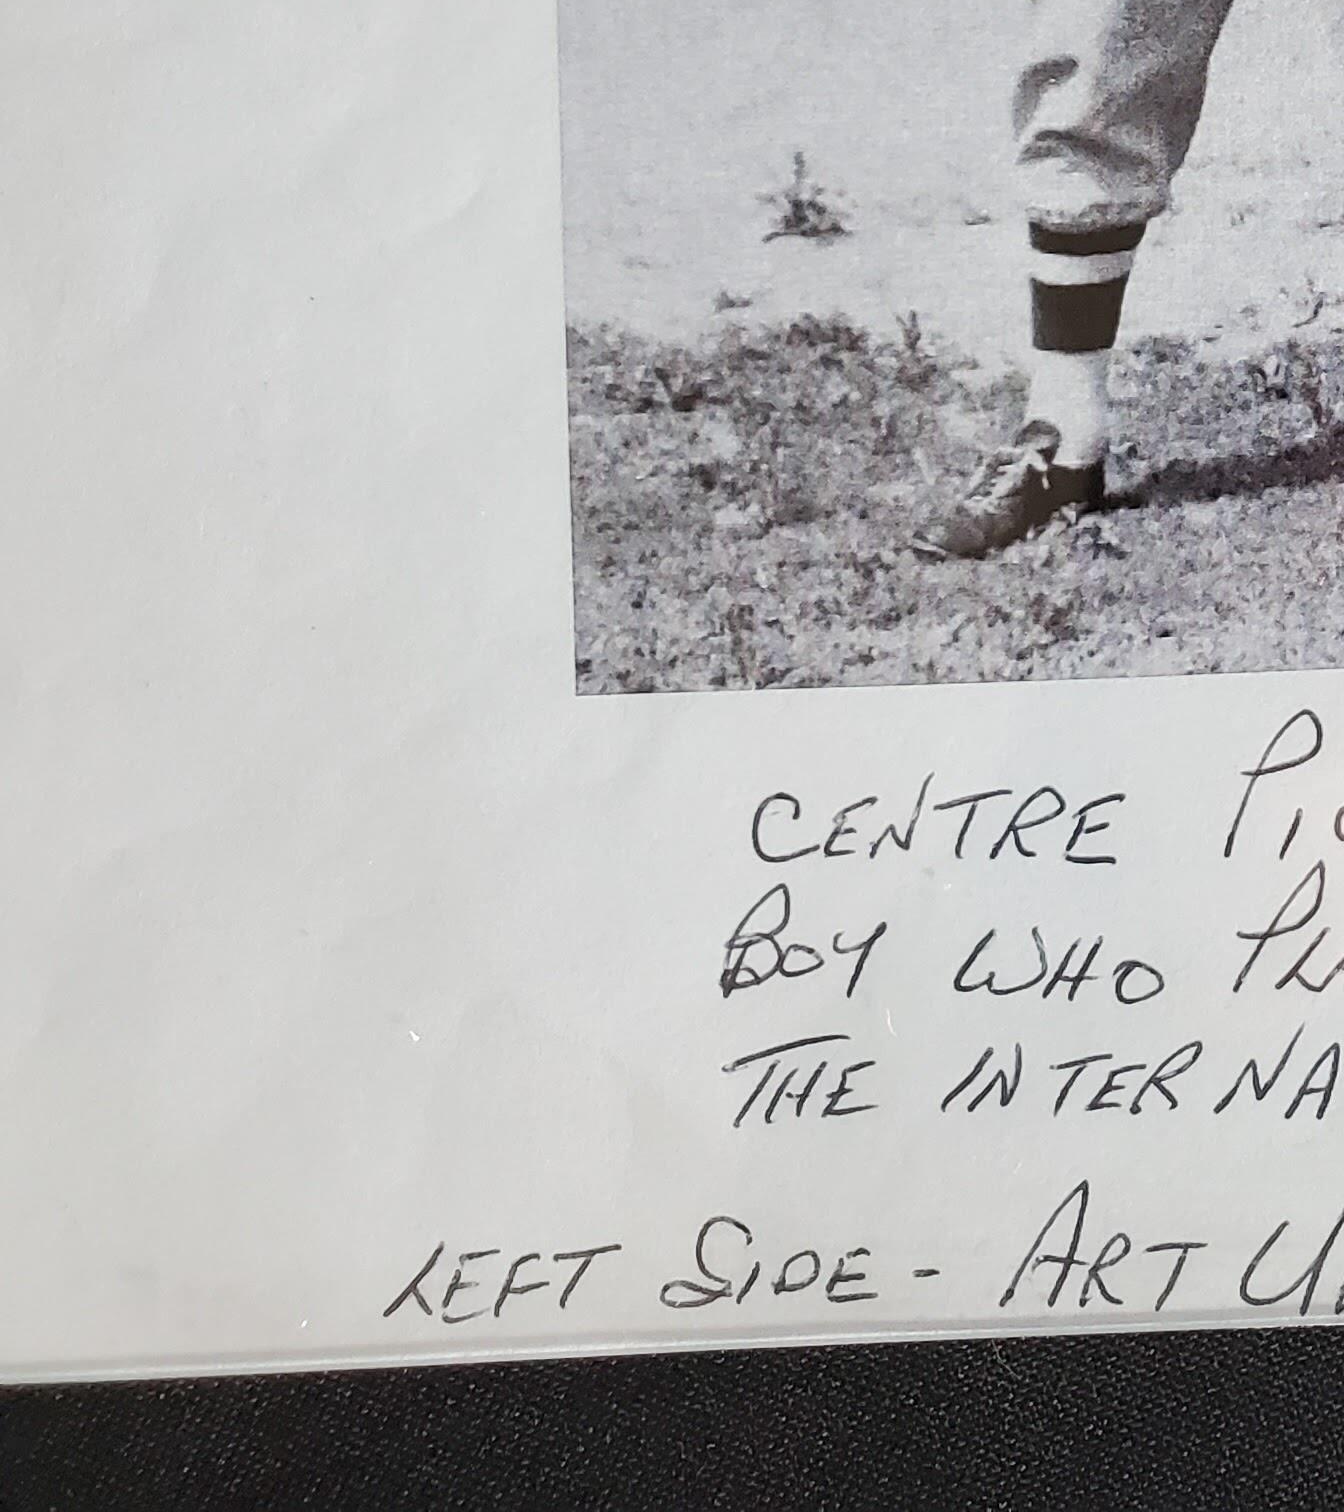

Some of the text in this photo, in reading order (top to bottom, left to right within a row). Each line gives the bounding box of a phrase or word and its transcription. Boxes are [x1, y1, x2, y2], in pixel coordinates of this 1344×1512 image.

[752, 772, 1126, 865] CENTRE
[718, 883, 887, 999] BOY
[953, 926, 1165, 1005] WHO
[721, 1034, 879, 1128] THE
[383, 1241, 622, 1324] LEFT
[660, 1216, 878, 1309] SIDE
[999, 1179, 1208, 1312] ART
